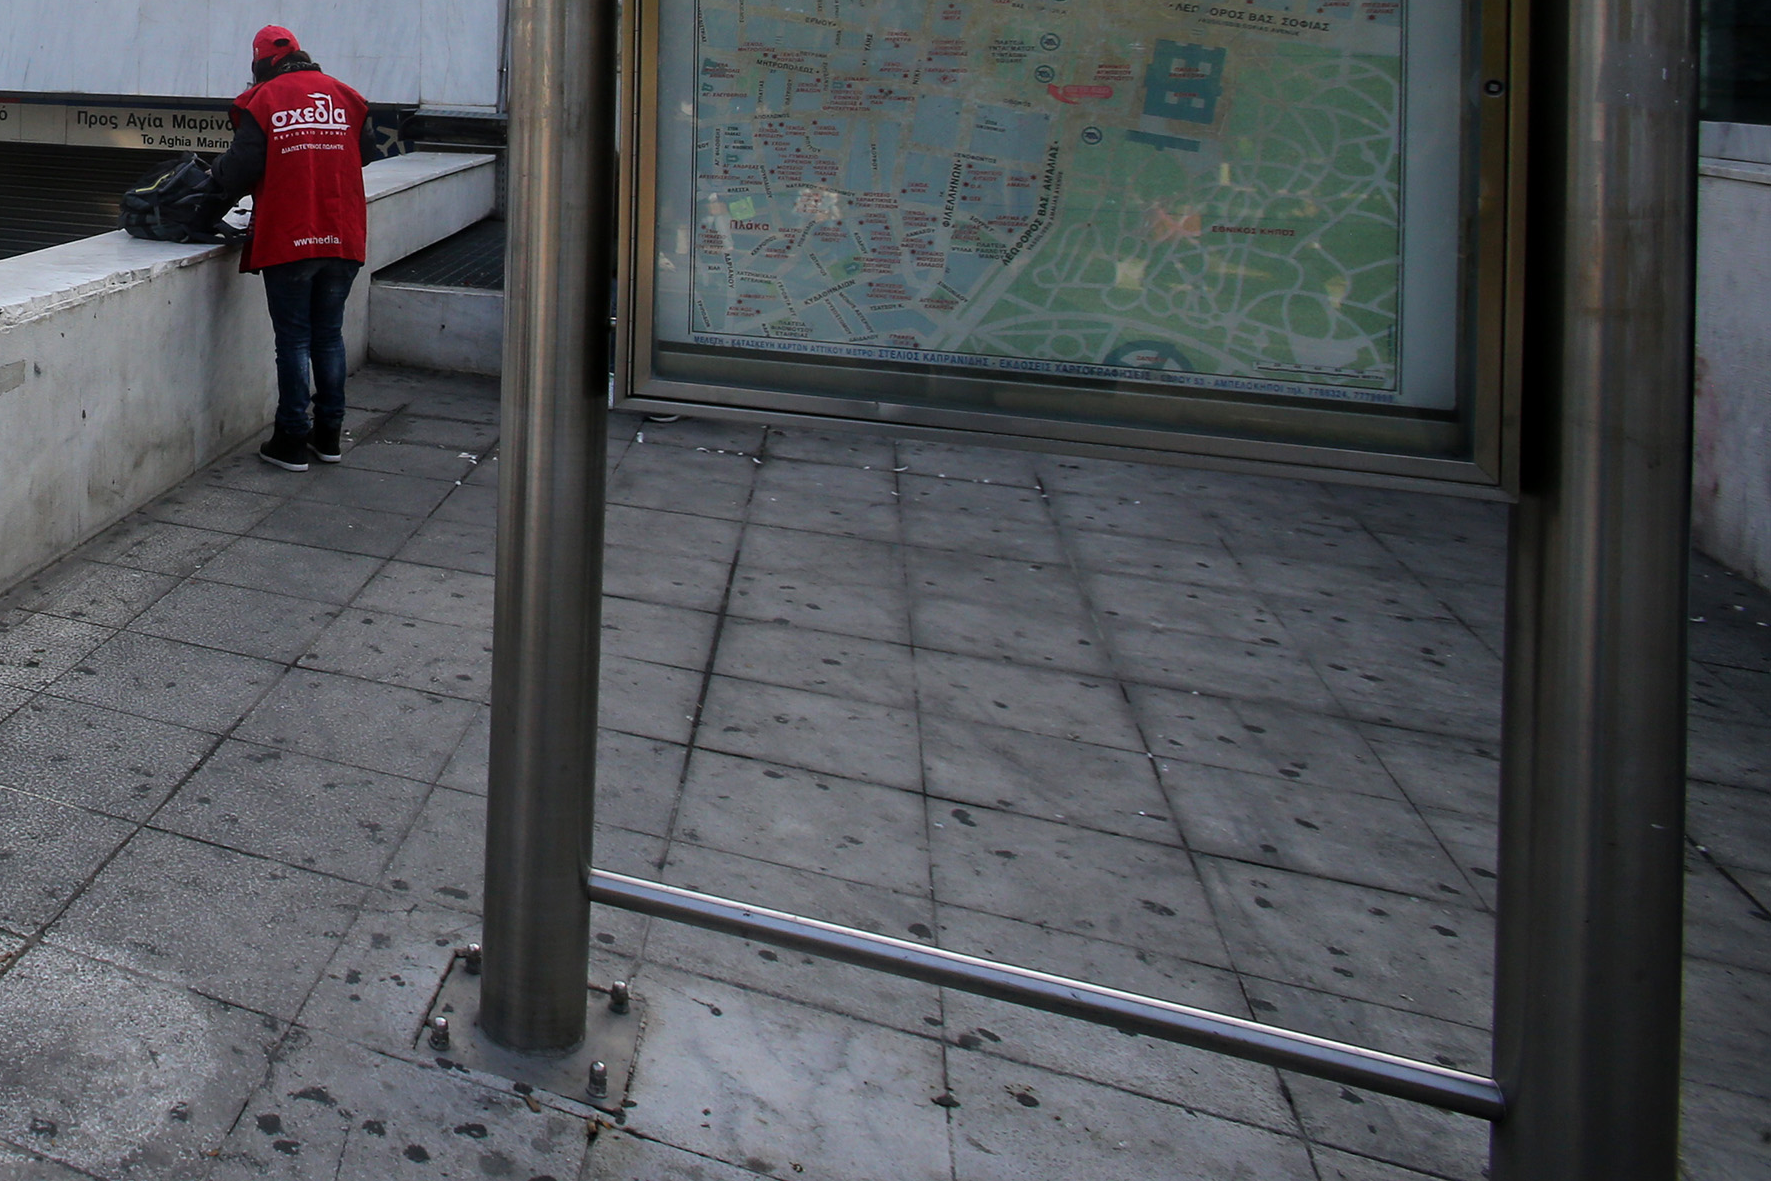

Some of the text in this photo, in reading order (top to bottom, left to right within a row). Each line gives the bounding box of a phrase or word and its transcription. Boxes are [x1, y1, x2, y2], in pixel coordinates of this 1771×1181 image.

[1281, 17, 1330, 32] ΣΟΦΙΑΣ
[77, 110, 118, 129] Προς
[126, 112, 163, 131] Αγία
[141, 134, 154, 145] To
[159, 135, 192, 148] Aghia
[942, 162, 962, 227] ΦΙΛΕΛΛΗΝΩΝ
[1003, 218, 1044, 266] ΛΕΩΦΟΡΟΣ
[1043, 147, 1059, 191] ΑΜΑΛΙΑΣ
[730, 219, 769, 231] Πλάκα
[731, 340, 775, 349] ΚΑΤΑΣΚΕΥΗ
[778, 343, 807, 352] ΧΑΡΤΩΝ
[810, 346, 843, 355] ΑΤΤΙΚΟΥ
[878, 349, 920, 361] ΣΤΕΛΙΟΣ
[923, 353, 988, 367] ΚΑΠΡΑΝΙΔΗΣ
[999, 359, 1052, 372] ΕΚΔΟΣΕΙΣ
